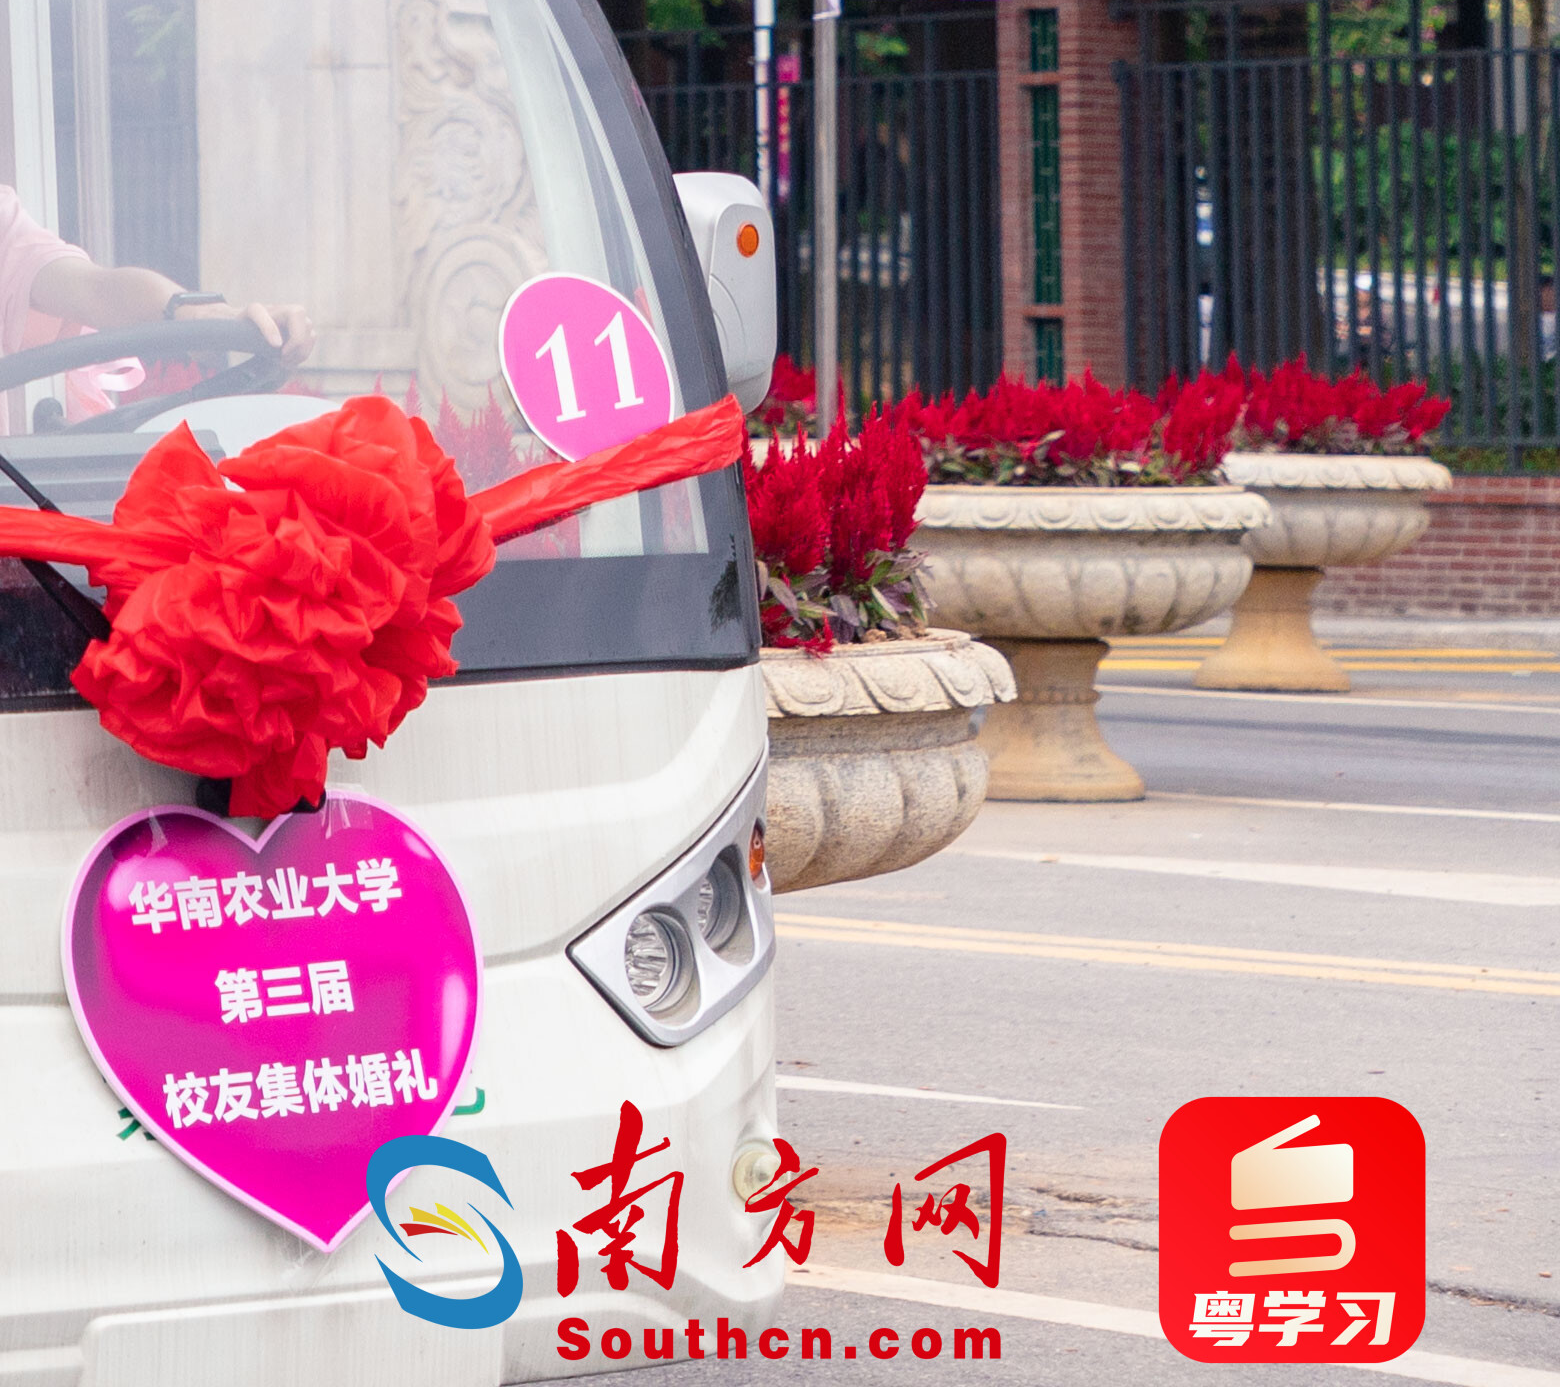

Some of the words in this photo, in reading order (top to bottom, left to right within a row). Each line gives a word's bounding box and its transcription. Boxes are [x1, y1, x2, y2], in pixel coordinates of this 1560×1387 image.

[535, 311, 645, 423] 11
[128, 857, 403, 935] 华南农业大学
[214, 960, 356, 1024] 第三届
[163, 1049, 439, 1129] 校友集体婚礼
